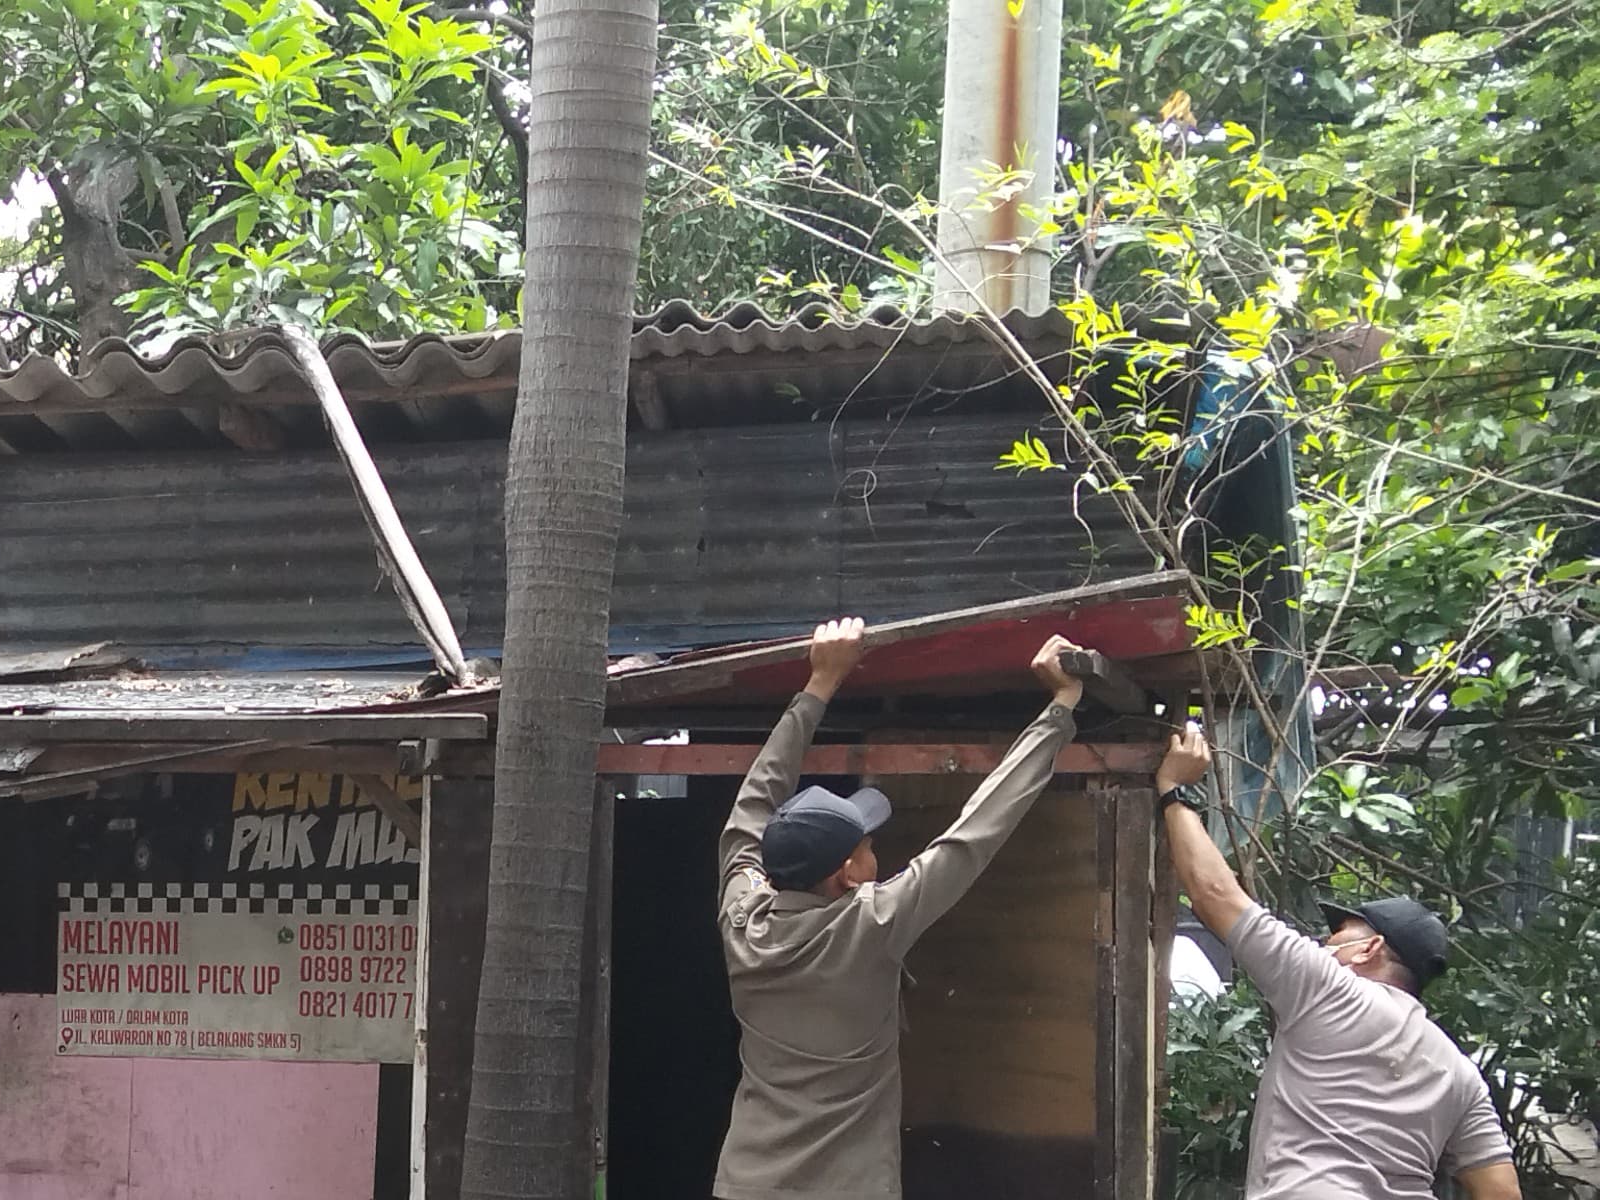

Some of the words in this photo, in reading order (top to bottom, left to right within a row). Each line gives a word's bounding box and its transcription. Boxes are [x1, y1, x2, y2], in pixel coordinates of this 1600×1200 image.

[228, 812, 320, 872] PAK
[325, 810, 421, 871] MU
[63, 920, 179, 955] MELAYANI
[299, 924, 346, 951] 0851
[353, 924, 395, 951] 0131
[401, 925, 418, 951] 0
[63, 963, 119, 993] SEWA
[128, 964, 190, 994] MOBIL
[198, 965, 247, 995] PICK
[253, 966, 280, 995] UP
[300, 956, 353, 982] 0898
[360, 957, 406, 984] 9722
[61, 1009, 87, 1023] LUAR
[90, 1009, 115, 1024] KOTA
[126, 1010, 160, 1025] DALAM
[163, 1010, 189, 1026] KOTA
[299, 991, 346, 1017] 0821
[352, 992, 397, 1019] 4017
[75, 1029, 87, 1044] JL.
[90, 1029, 153, 1046] KALIWARON
[156, 1030, 171, 1046] NO
[175, 1030, 187, 1046] 78
[198, 1031, 254, 1048] BELAKANG
[257, 1032, 287, 1049] SMKN
